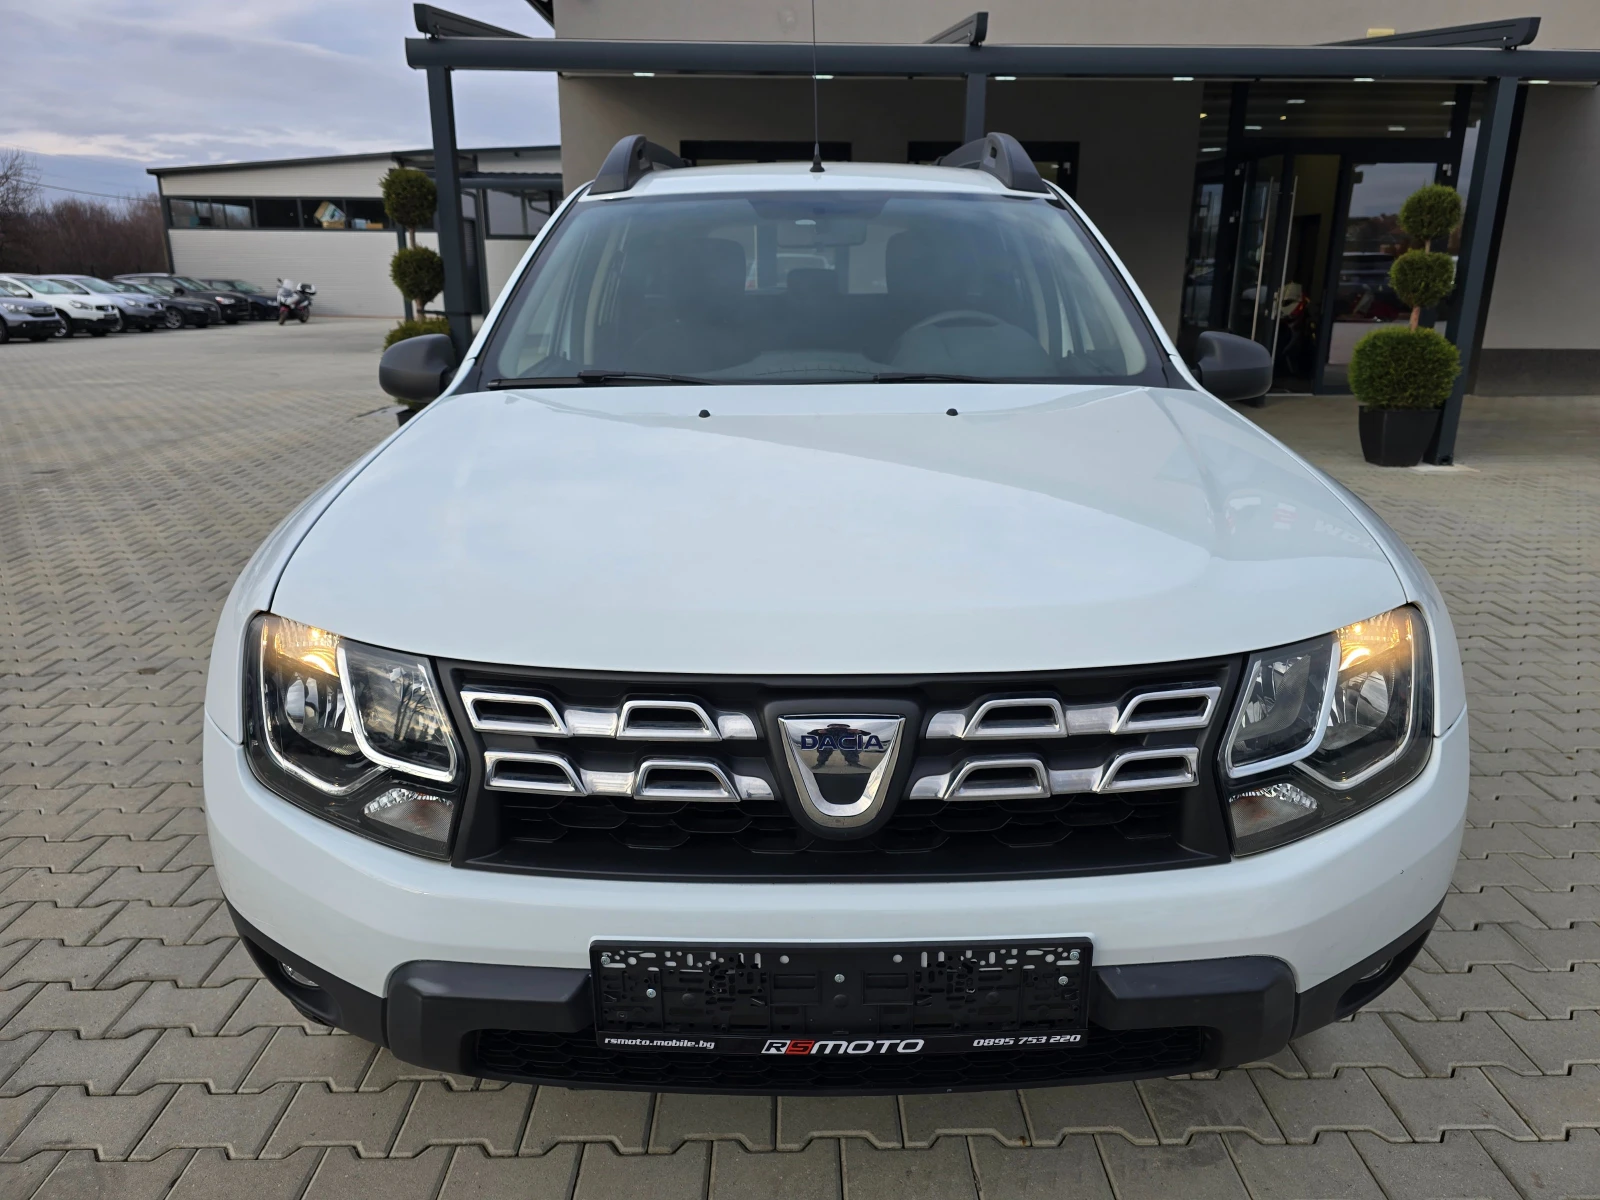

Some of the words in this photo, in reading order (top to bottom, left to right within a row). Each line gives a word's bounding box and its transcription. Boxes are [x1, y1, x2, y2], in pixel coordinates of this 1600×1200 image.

[801, 734, 884, 751] DACIA
[604, 1037, 716, 1050] rsmoto.mobile.bg
[761, 1039, 925, 1055] RSMOTO
[973, 1037, 1015, 1047] 0895
[1018, 1036, 1047, 1045] 753
[1049, 1034, 1081, 1043] 220
